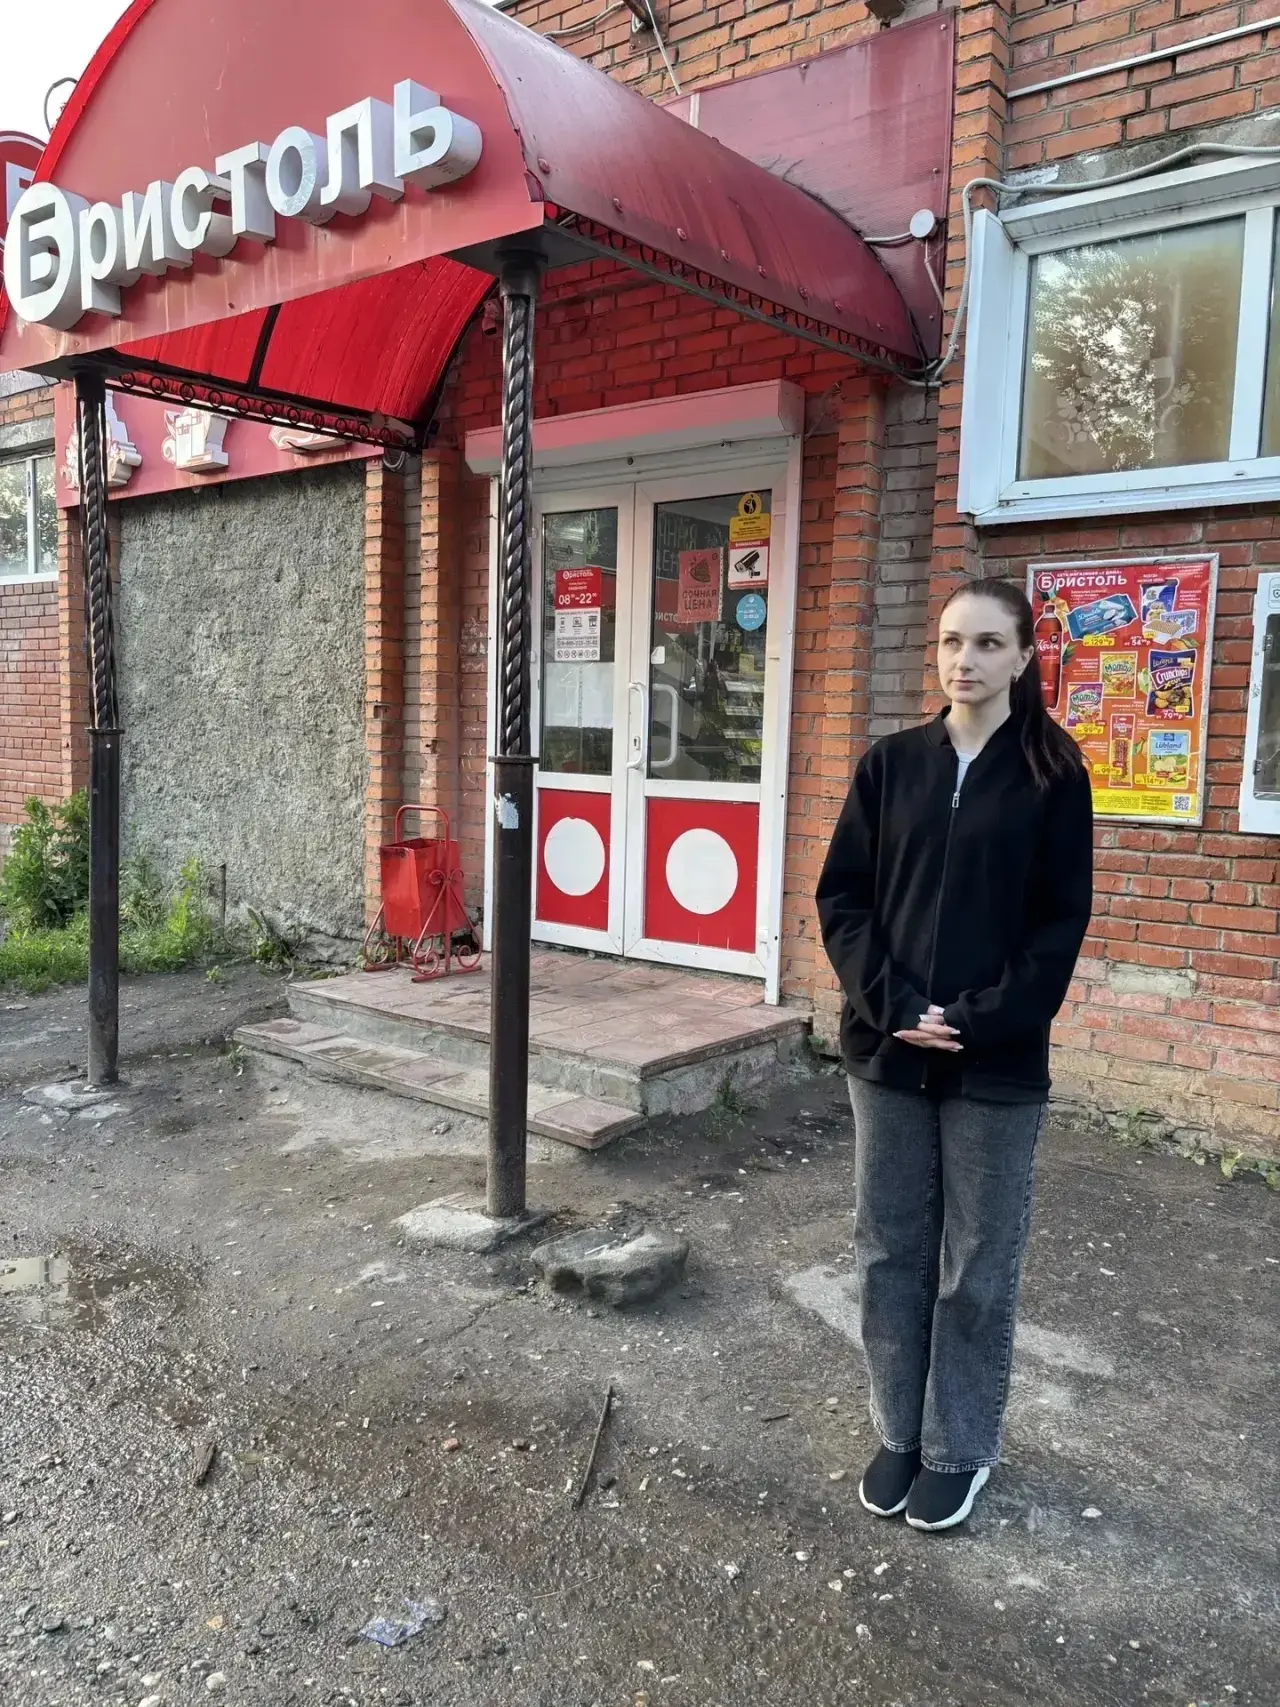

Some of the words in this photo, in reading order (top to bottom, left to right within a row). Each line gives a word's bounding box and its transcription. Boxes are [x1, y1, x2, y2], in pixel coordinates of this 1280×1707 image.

[4, 78, 479, 328] Бристоль
[1037, 573, 1127, 592] Бристоль
[684, 600, 713, 610] ЦЕНА
[1155, 668, 1188, 685] Crunchips
